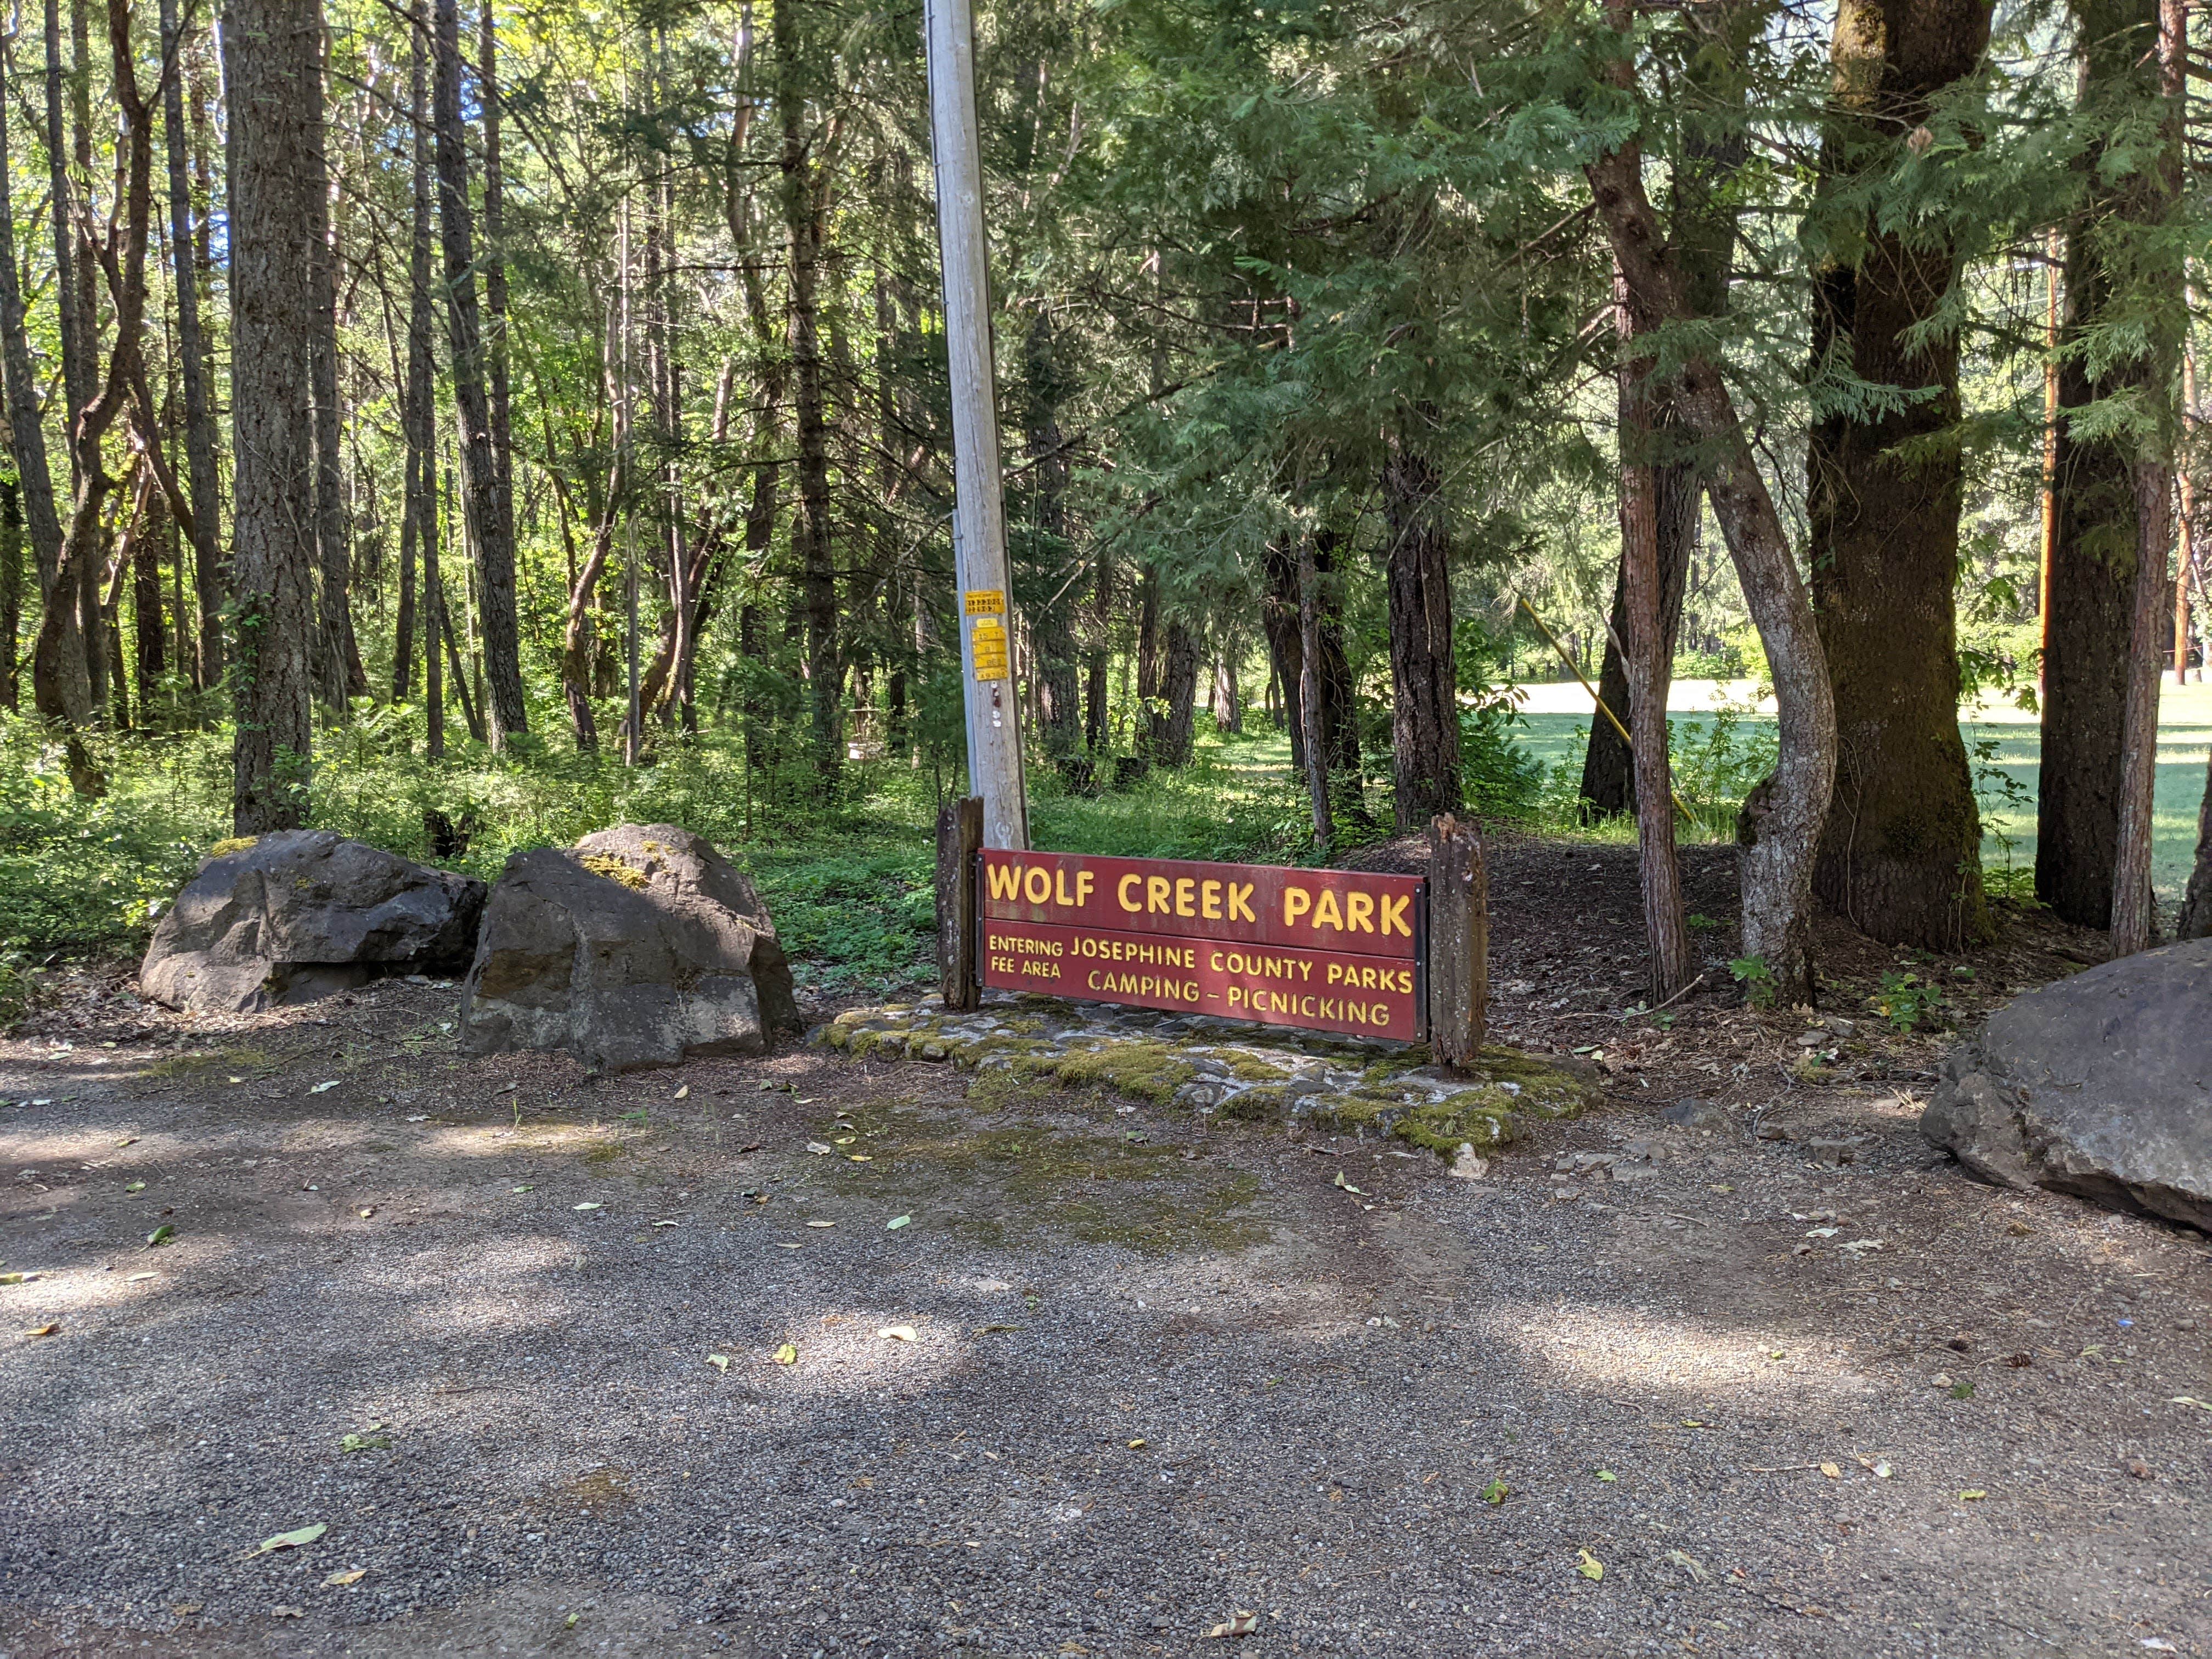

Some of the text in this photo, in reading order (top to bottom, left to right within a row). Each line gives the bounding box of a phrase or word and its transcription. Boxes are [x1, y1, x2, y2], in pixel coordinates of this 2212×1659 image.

[988, 864, 1412, 938] WOLF CREEK PARK
[989, 934, 1063, 957] ENTERING
[991, 956, 1061, 978] FEE AREA
[1071, 937, 1413, 994] JOSEPHINE COUNTY PARKS
[1088, 970, 1200, 1002] CAMPING
[1228, 985, 1390, 1026] PICNICKING
